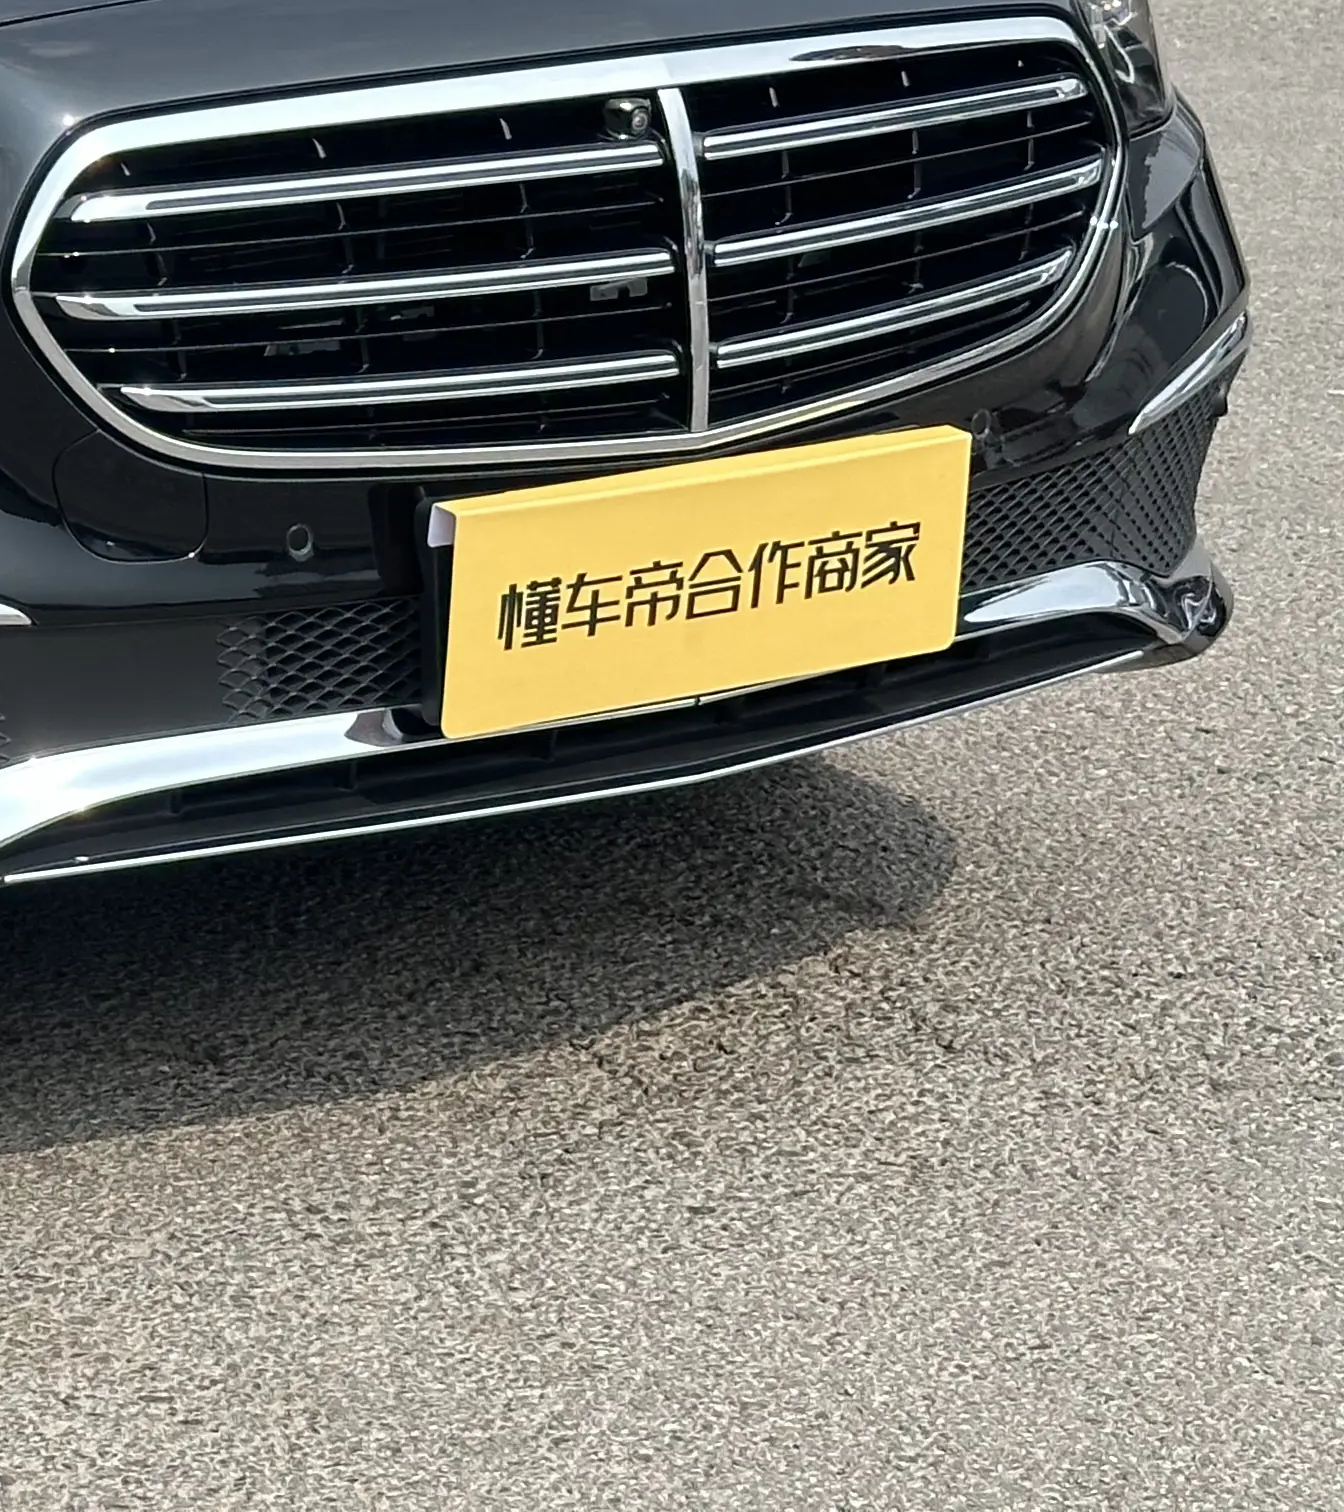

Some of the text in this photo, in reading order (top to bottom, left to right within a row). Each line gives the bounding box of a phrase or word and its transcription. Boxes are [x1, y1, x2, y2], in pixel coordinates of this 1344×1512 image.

[497, 519, 922, 652] 懂车帝合作商家
